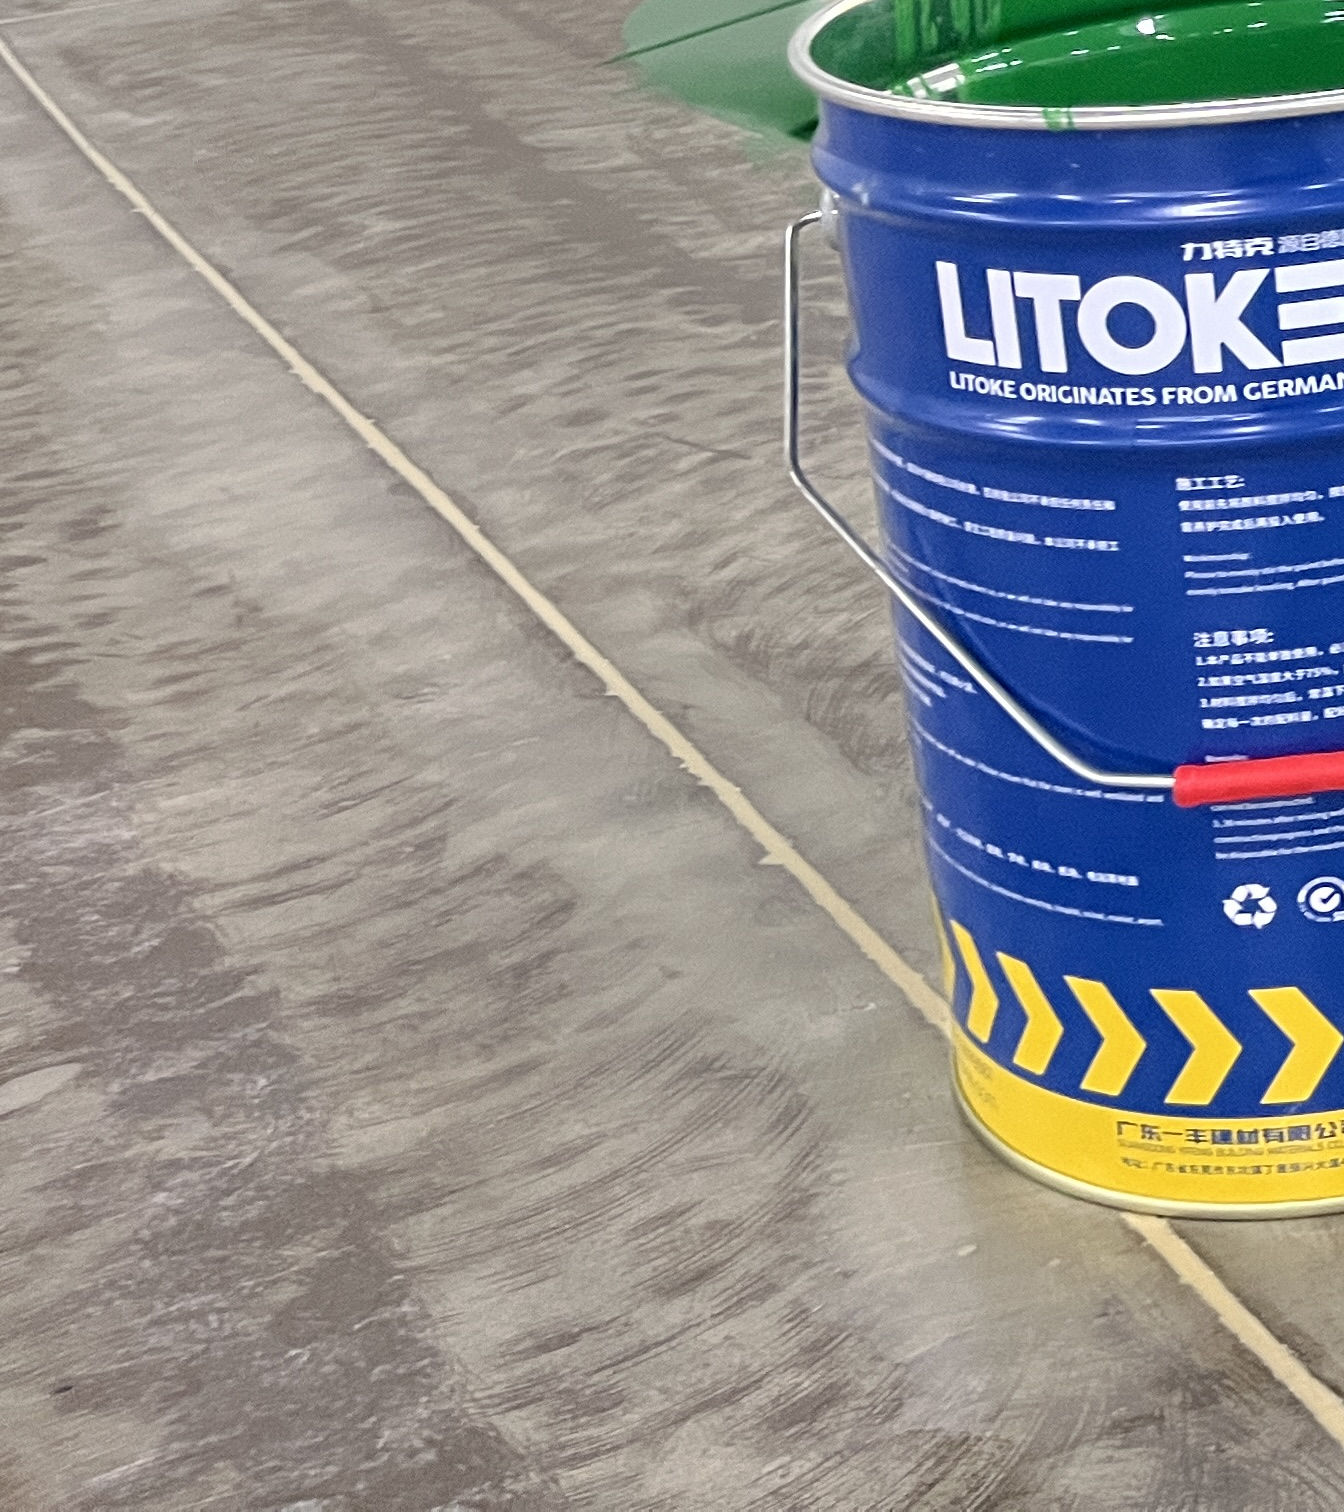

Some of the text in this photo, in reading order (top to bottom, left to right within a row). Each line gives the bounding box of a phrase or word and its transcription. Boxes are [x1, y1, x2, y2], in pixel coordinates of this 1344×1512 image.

[949, 371, 1018, 400] LITOKE
[1019, 382, 1157, 406] ORIGINATES
[1162, 383, 1238, 405] FROM
